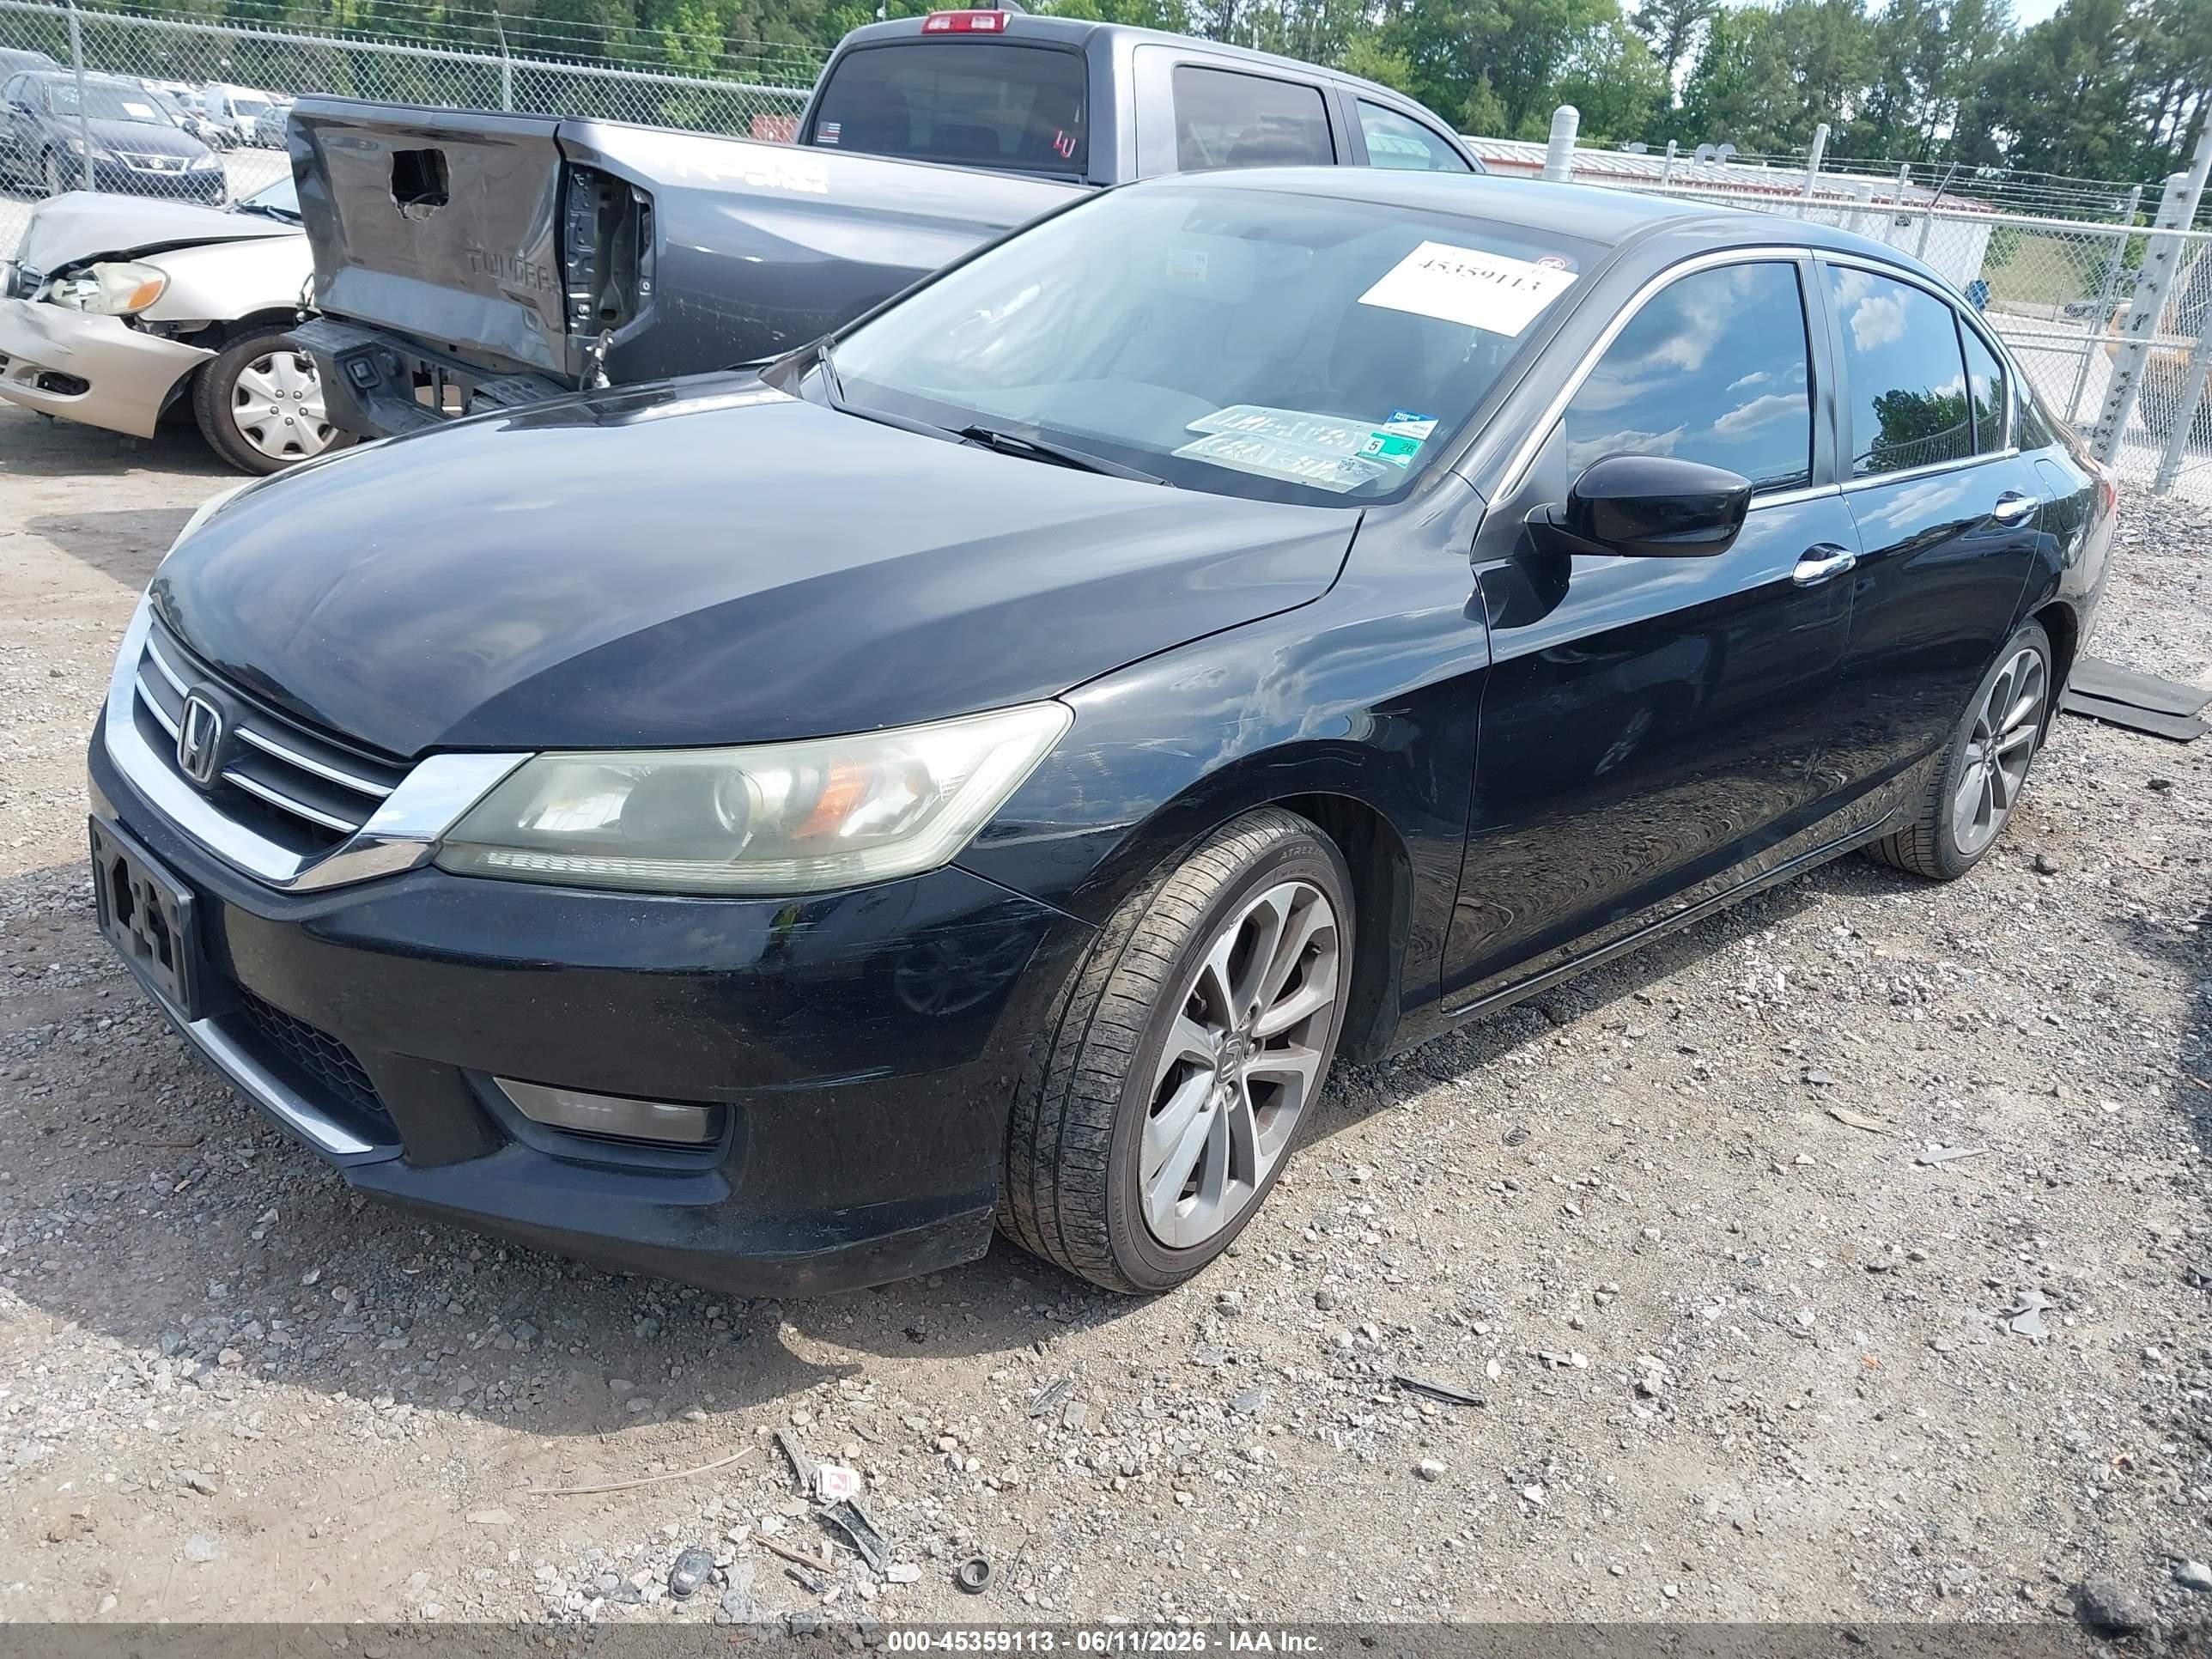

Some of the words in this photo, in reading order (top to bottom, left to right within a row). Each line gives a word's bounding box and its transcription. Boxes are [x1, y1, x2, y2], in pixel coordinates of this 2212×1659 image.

[1418, 258, 1542, 291] 45359113
[1368, 441, 1381, 451] 5
[1399, 442, 1417, 453] 26
